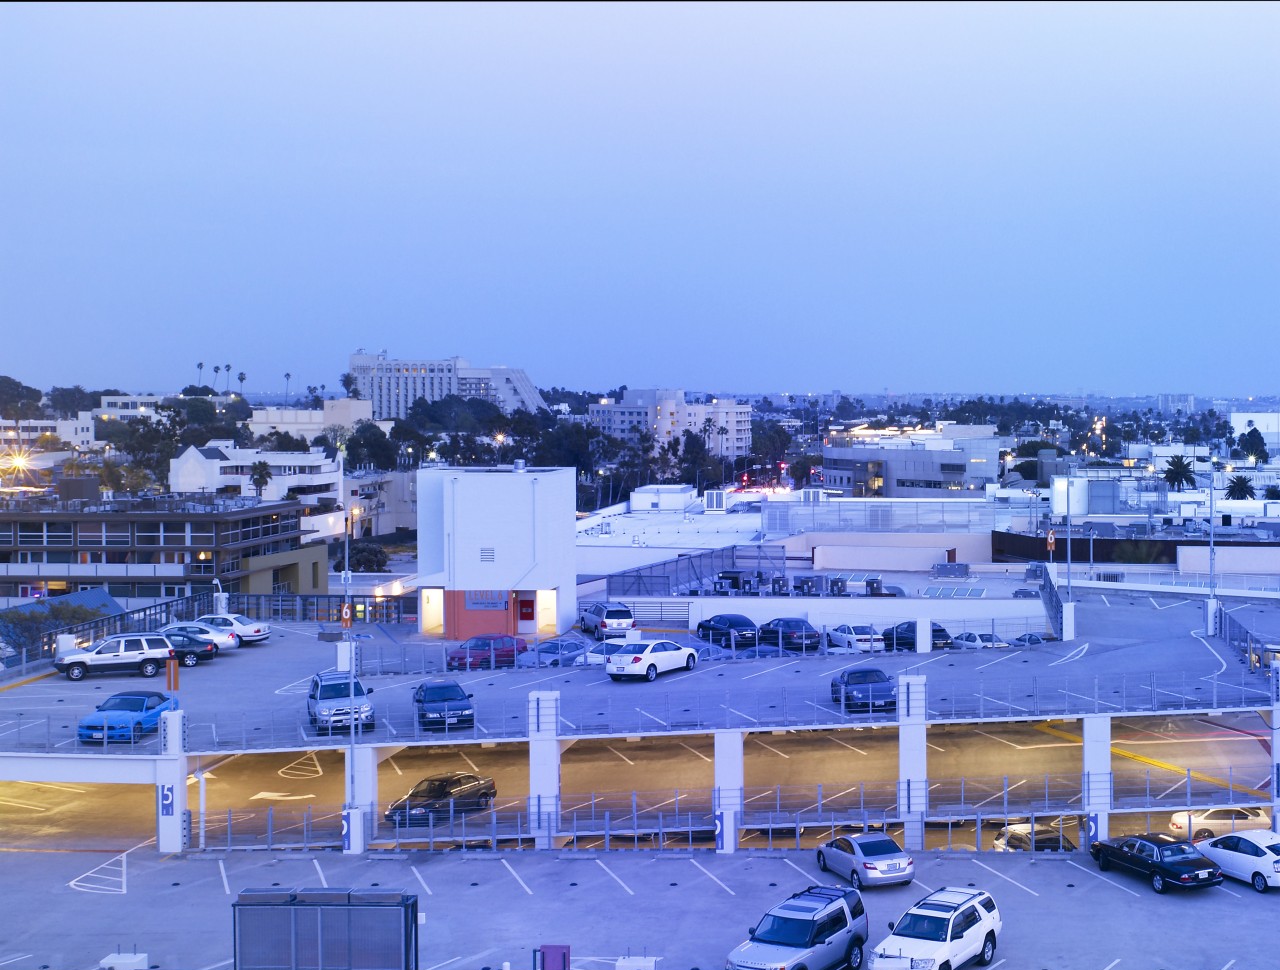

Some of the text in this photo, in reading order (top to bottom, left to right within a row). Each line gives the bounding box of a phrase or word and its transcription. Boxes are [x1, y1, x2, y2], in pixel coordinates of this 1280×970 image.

[1048, 530, 1055, 542] 6
[342, 603, 350, 619] 6
[163, 785, 173, 804] 5
